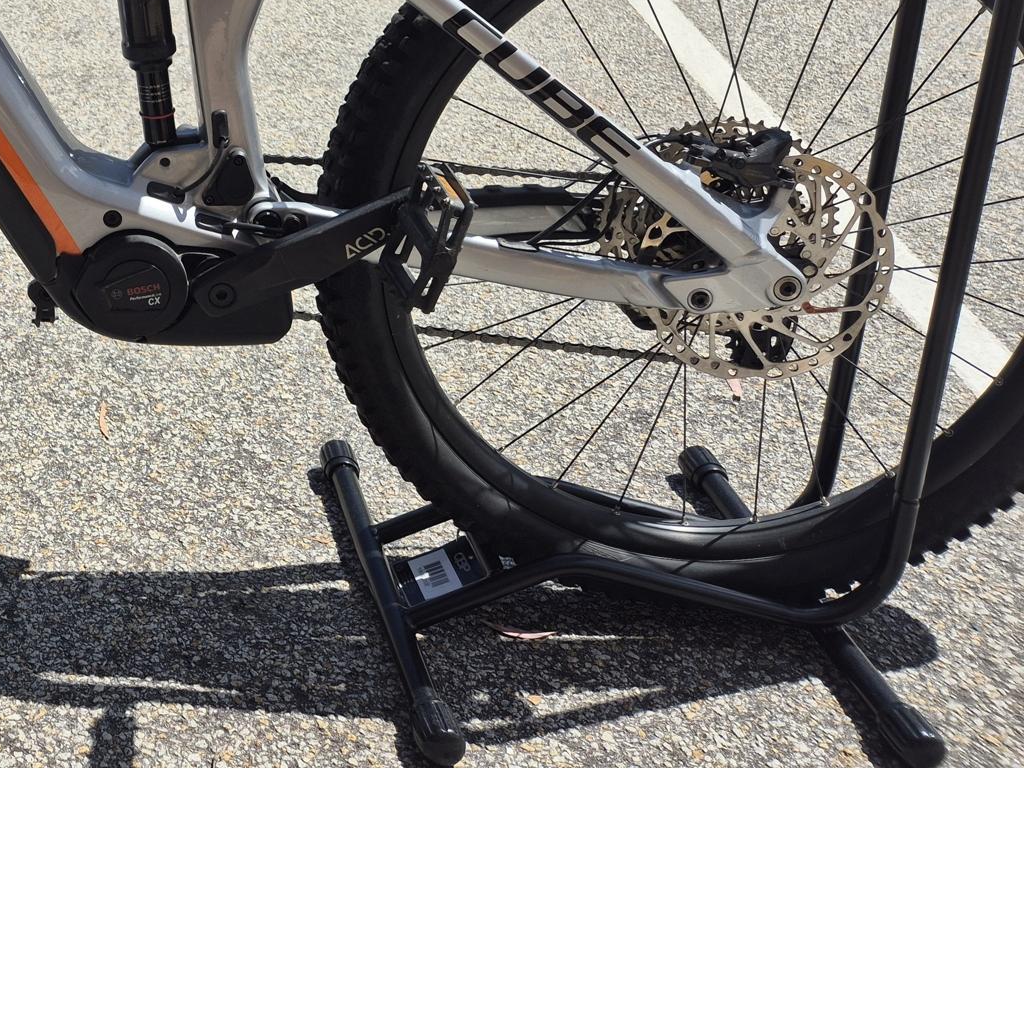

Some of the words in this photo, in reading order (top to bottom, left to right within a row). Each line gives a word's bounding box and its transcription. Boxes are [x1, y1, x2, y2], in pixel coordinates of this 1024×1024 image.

[443, 9, 641, 165] CUBE
[345, 227, 386, 260] ACID
[127, 283, 161, 297] BOSCH
[147, 296, 161, 306] CX
